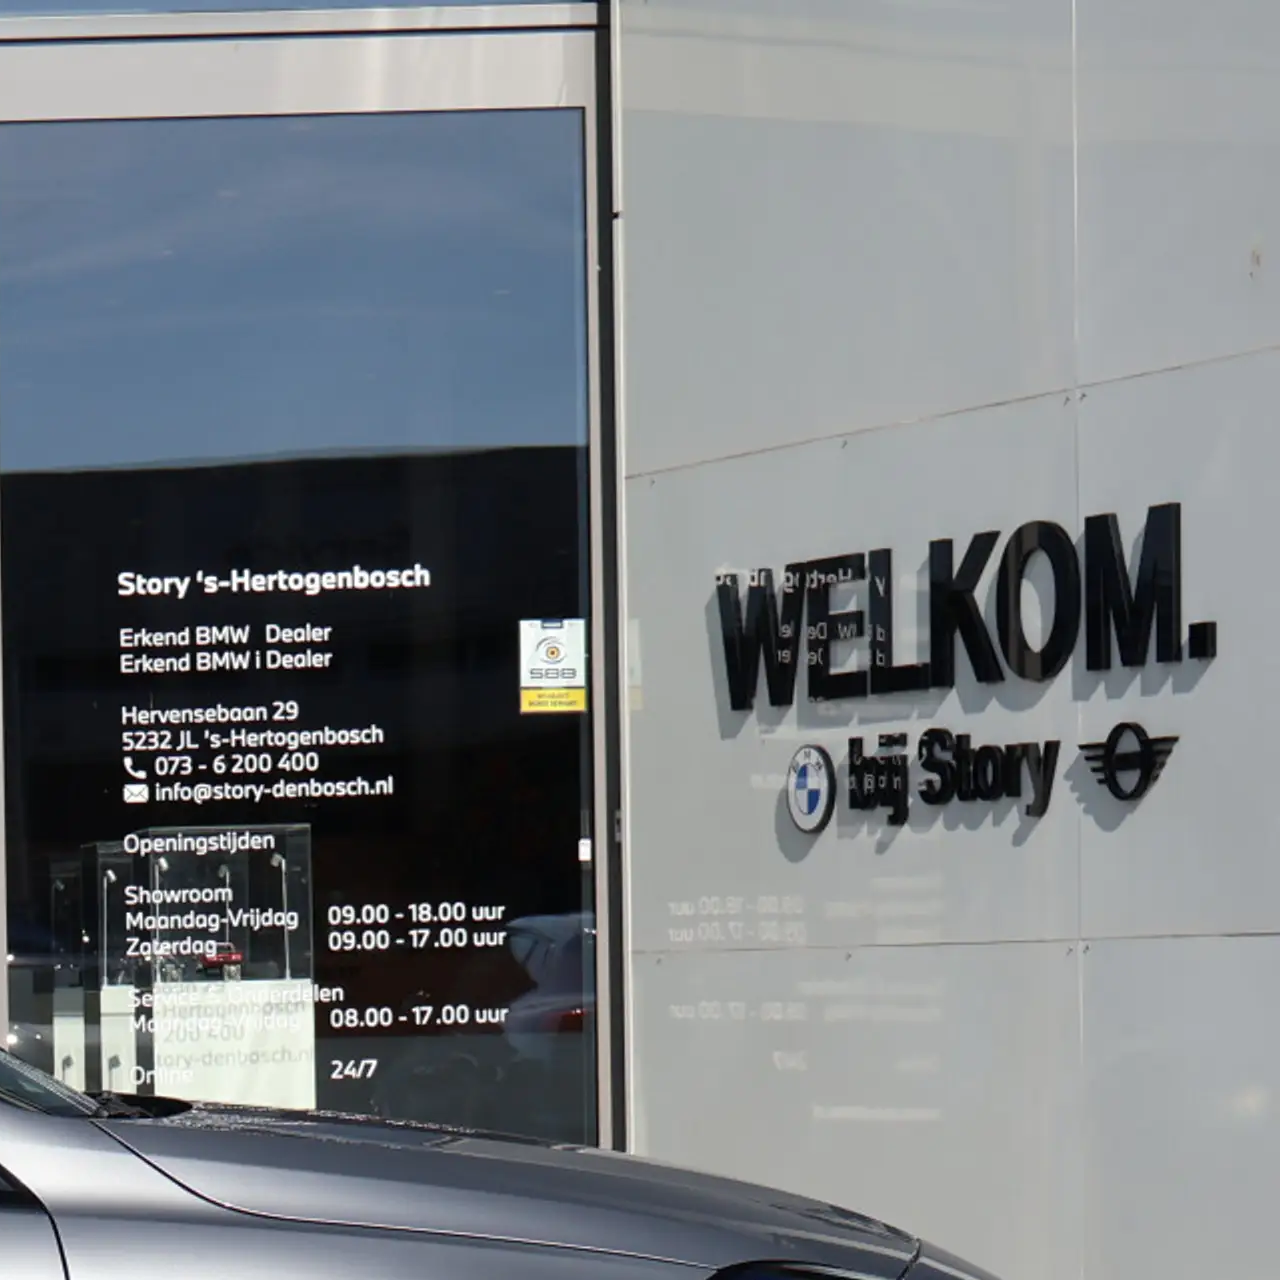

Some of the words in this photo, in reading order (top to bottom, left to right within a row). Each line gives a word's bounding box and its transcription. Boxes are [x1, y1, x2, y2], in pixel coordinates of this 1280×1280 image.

[118, 572, 190, 599] Story
[197, 564, 431, 595] 's-Hertogenbosch
[716, 502, 1217, 711] WELKOM.
[120, 627, 190, 648] Erkend
[196, 625, 250, 645] BMW
[266, 623, 333, 643] Dealer
[120, 653, 190, 673] Erkend
[196, 651, 250, 671] BMW
[256, 650, 261, 670] i
[267, 649, 333, 669] Dealer
[122, 702, 268, 725] Hervensebaan
[273, 701, 299, 720] 29
[123, 730, 172, 751] 5232
[177, 730, 200, 750] JL
[205, 724, 384, 750] 's-Hertogenbosch
[155, 756, 192, 776] 073
[213, 755, 227, 774] 6
[232, 754, 272, 774] 200
[278, 752, 320, 772] 400
[848, 732, 909, 826] bij
[918, 728, 1061, 819] Story
[156, 774, 394, 802] info@story-denbosch.nl
[123, 832, 276, 856] Openingstijden
[124, 886, 234, 906] Showroom
[125, 908, 299, 933] Maandag-Vrijdag
[328, 904, 390, 925] 09.00
[408, 902, 466, 922] 18.00
[472, 905, 506, 921] uur
[126, 936, 218, 957] Zaterdag
[328, 930, 390, 951] 09.00
[473, 931, 507, 947] uur
[331, 1007, 393, 1028] 08.00
[476, 1008, 510, 1024] uur
[130, 1065, 194, 1085] Online
[331, 1059, 378, 1080] 24/7
